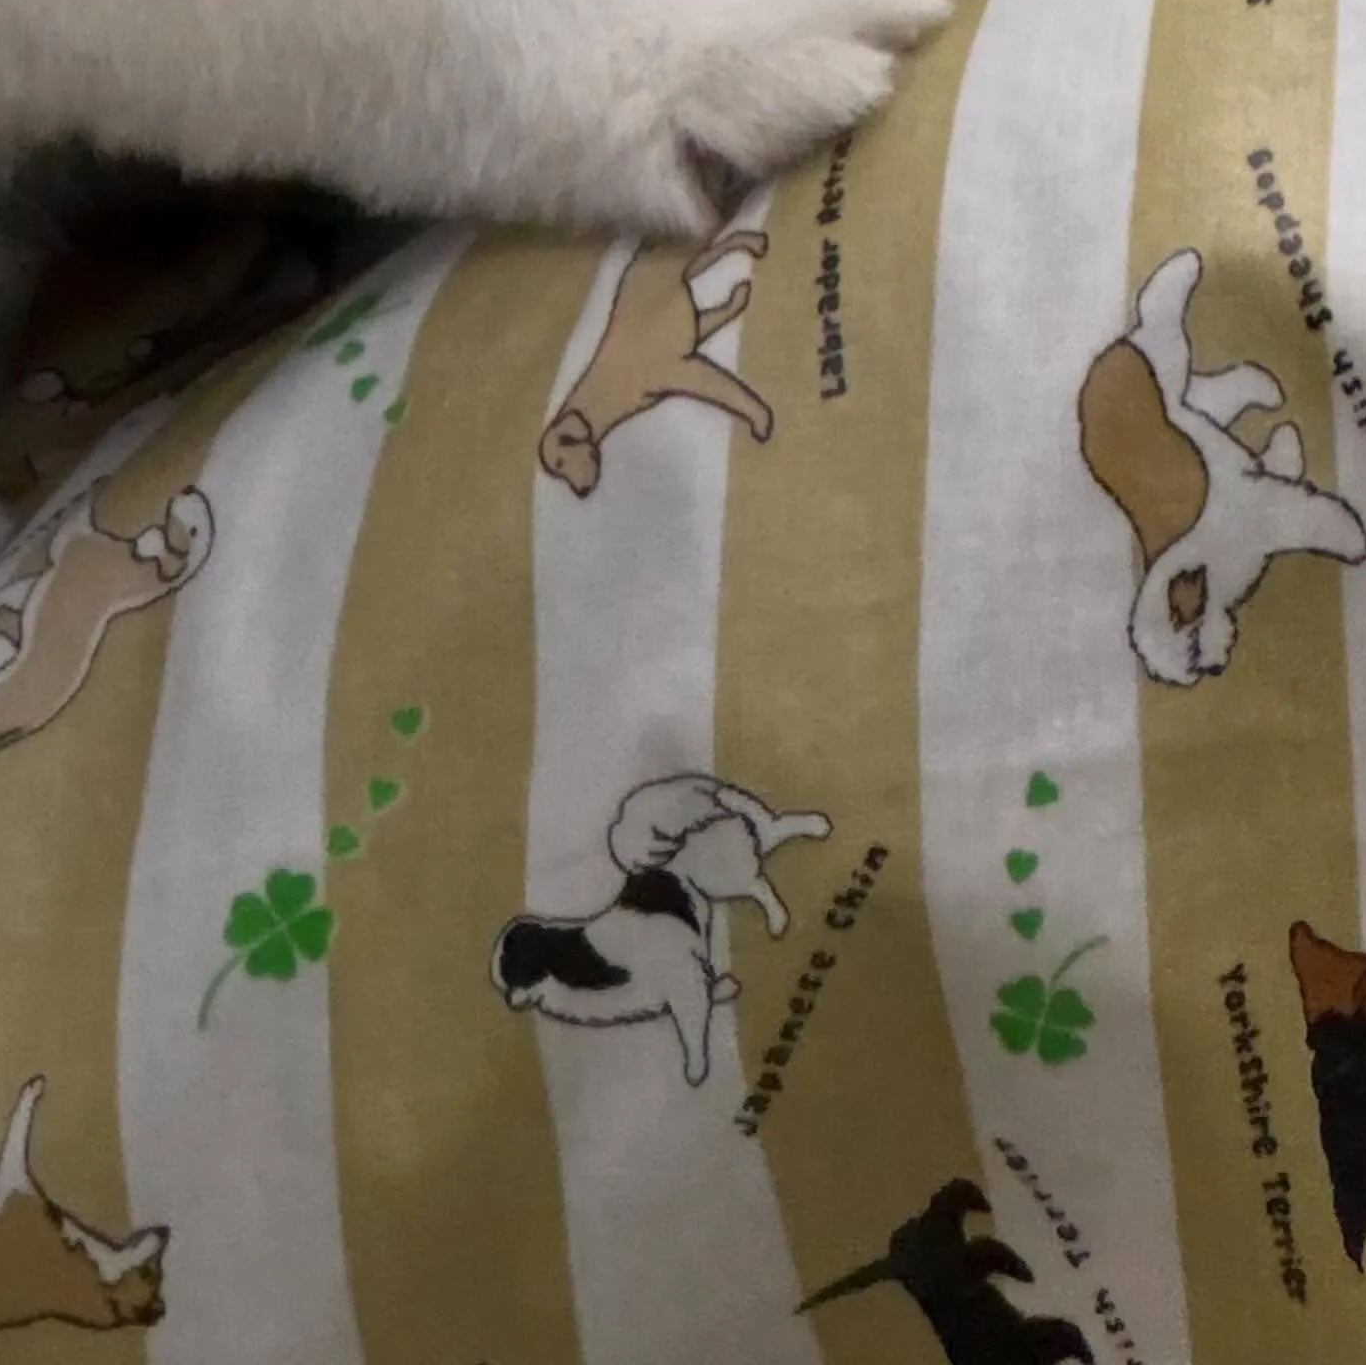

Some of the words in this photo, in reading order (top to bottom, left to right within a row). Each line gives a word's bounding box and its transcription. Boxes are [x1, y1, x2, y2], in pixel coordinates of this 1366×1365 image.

[814, 239, 847, 401] Labrador
[1247, 148, 1333, 333] Sheepdog
[736, 948, 836, 1137] Japanese
[825, 843, 890, 933] Chin
[993, 1136, 1092, 1269] Terrier
[1217, 962, 1279, 1158] Yorkshire
[1261, 1171, 1308, 1306] Terrier
